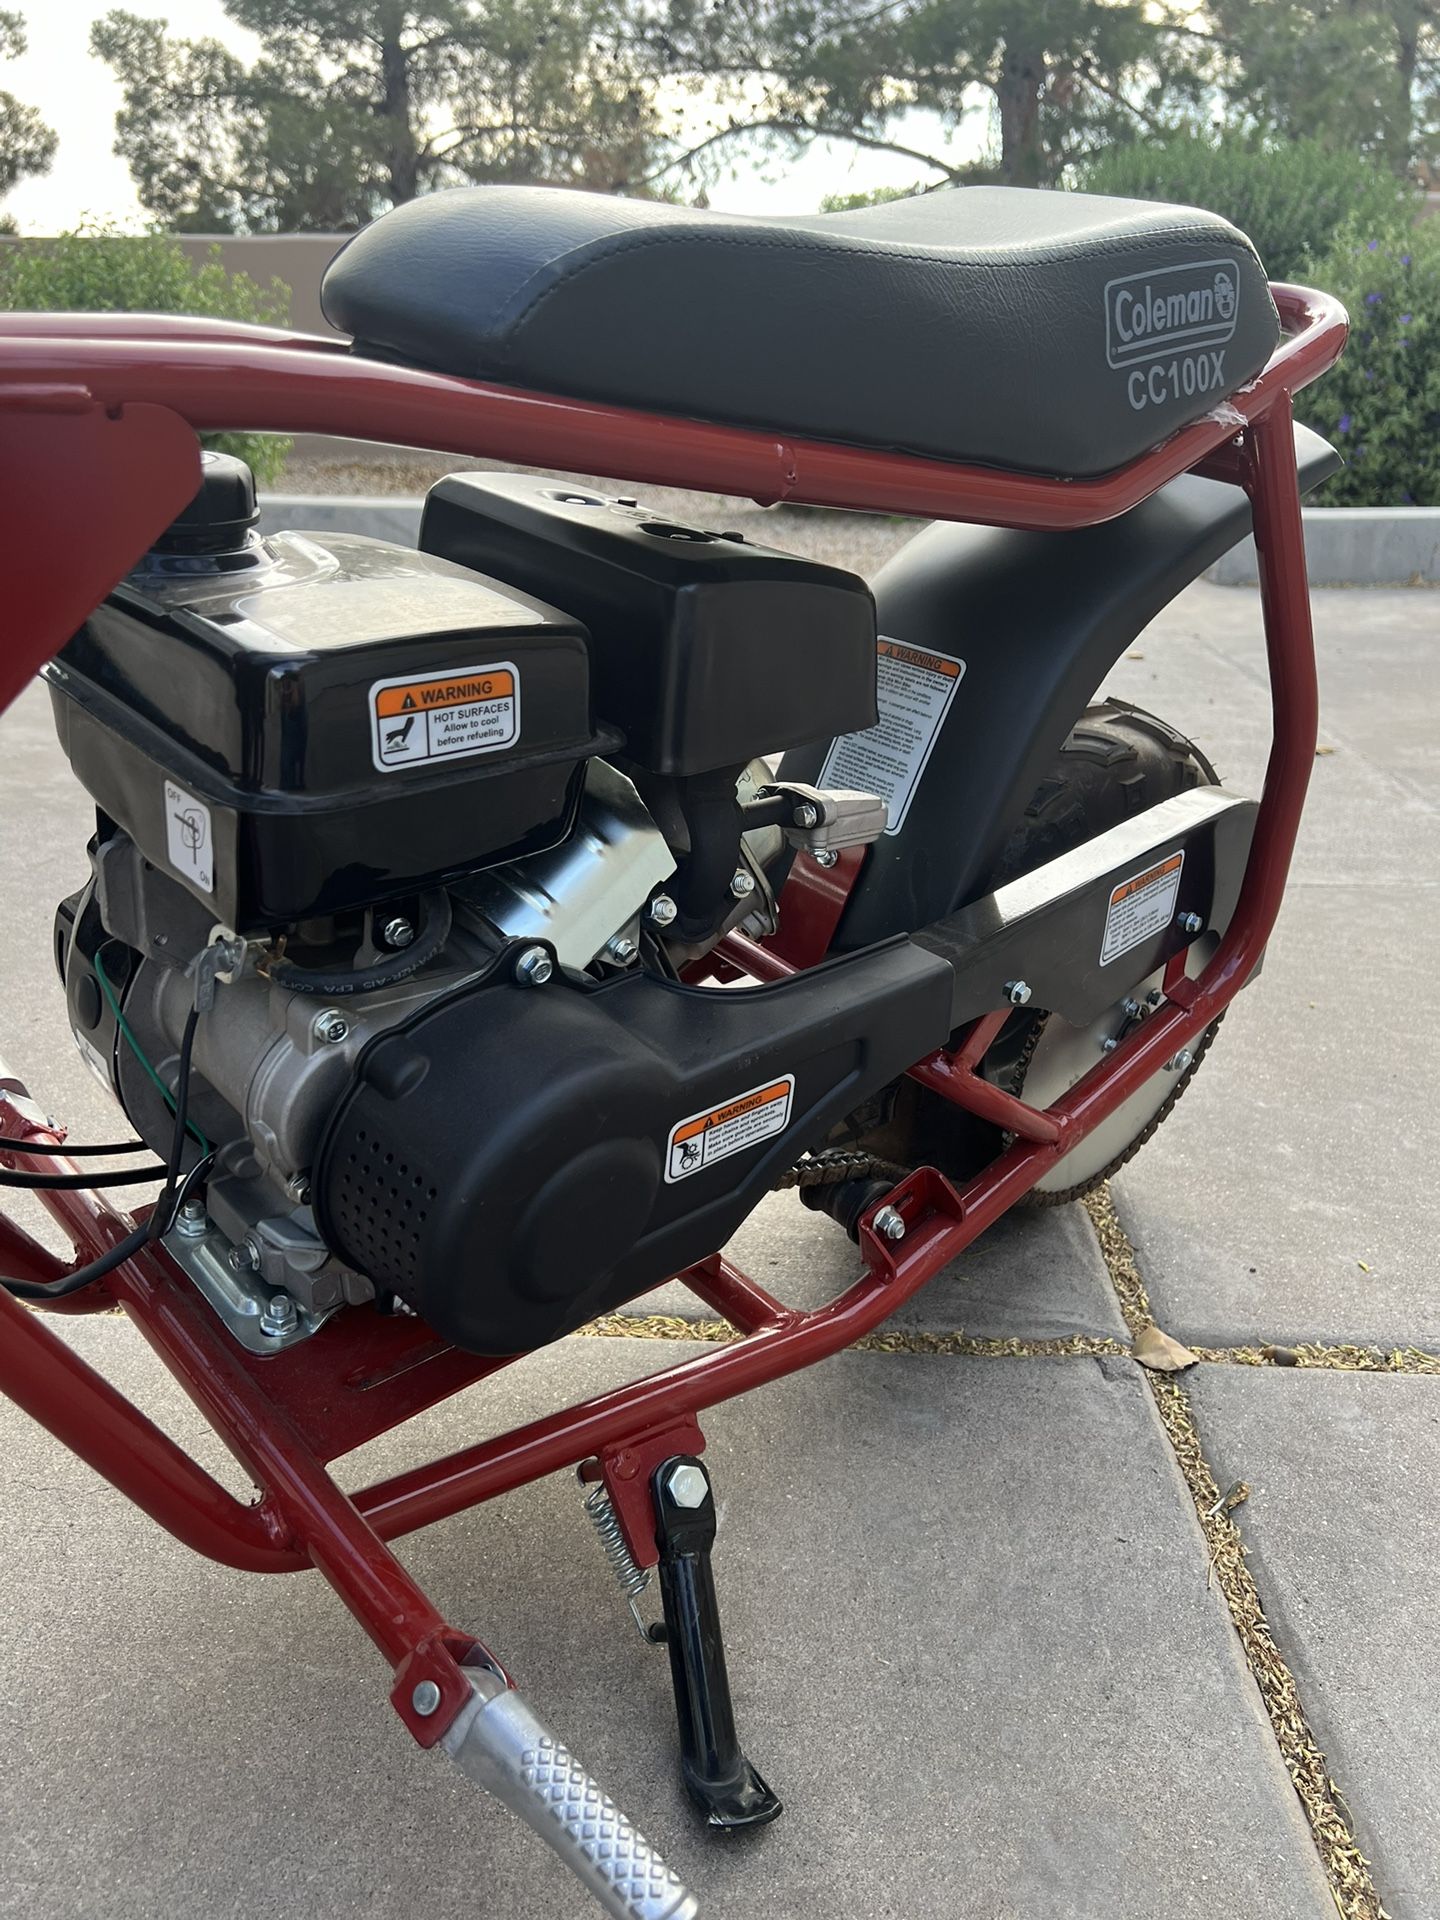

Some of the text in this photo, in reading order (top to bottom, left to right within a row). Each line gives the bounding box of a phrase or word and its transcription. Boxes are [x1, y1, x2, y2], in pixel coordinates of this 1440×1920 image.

[1115, 285, 1214, 342] Coleman
[1128, 350, 1226, 410] CC100X
[897, 647, 942, 669] WARNING
[421, 680, 493, 704] WARNING
[434, 701, 510, 724] HOT SURFACES
[443, 715, 500, 733] Allow to cool
[437, 727, 505, 747] before refueling
[167, 787, 181, 803] OFF
[200, 870, 210, 886] ON
[1135, 865, 1165, 889] WARNING
[709, 1100, 783, 1136] Keep hands and fingers away
[717, 1095, 762, 1121] WARNING
[708, 1134, 721, 1142] from
[721, 1125, 739, 1136] chains
[740, 1118, 750, 1127] and
[708, 1112, 784, 1149] Make sure guards are securely
[713, 1143, 727, 1154] place
[728, 1135, 744, 1147] before
